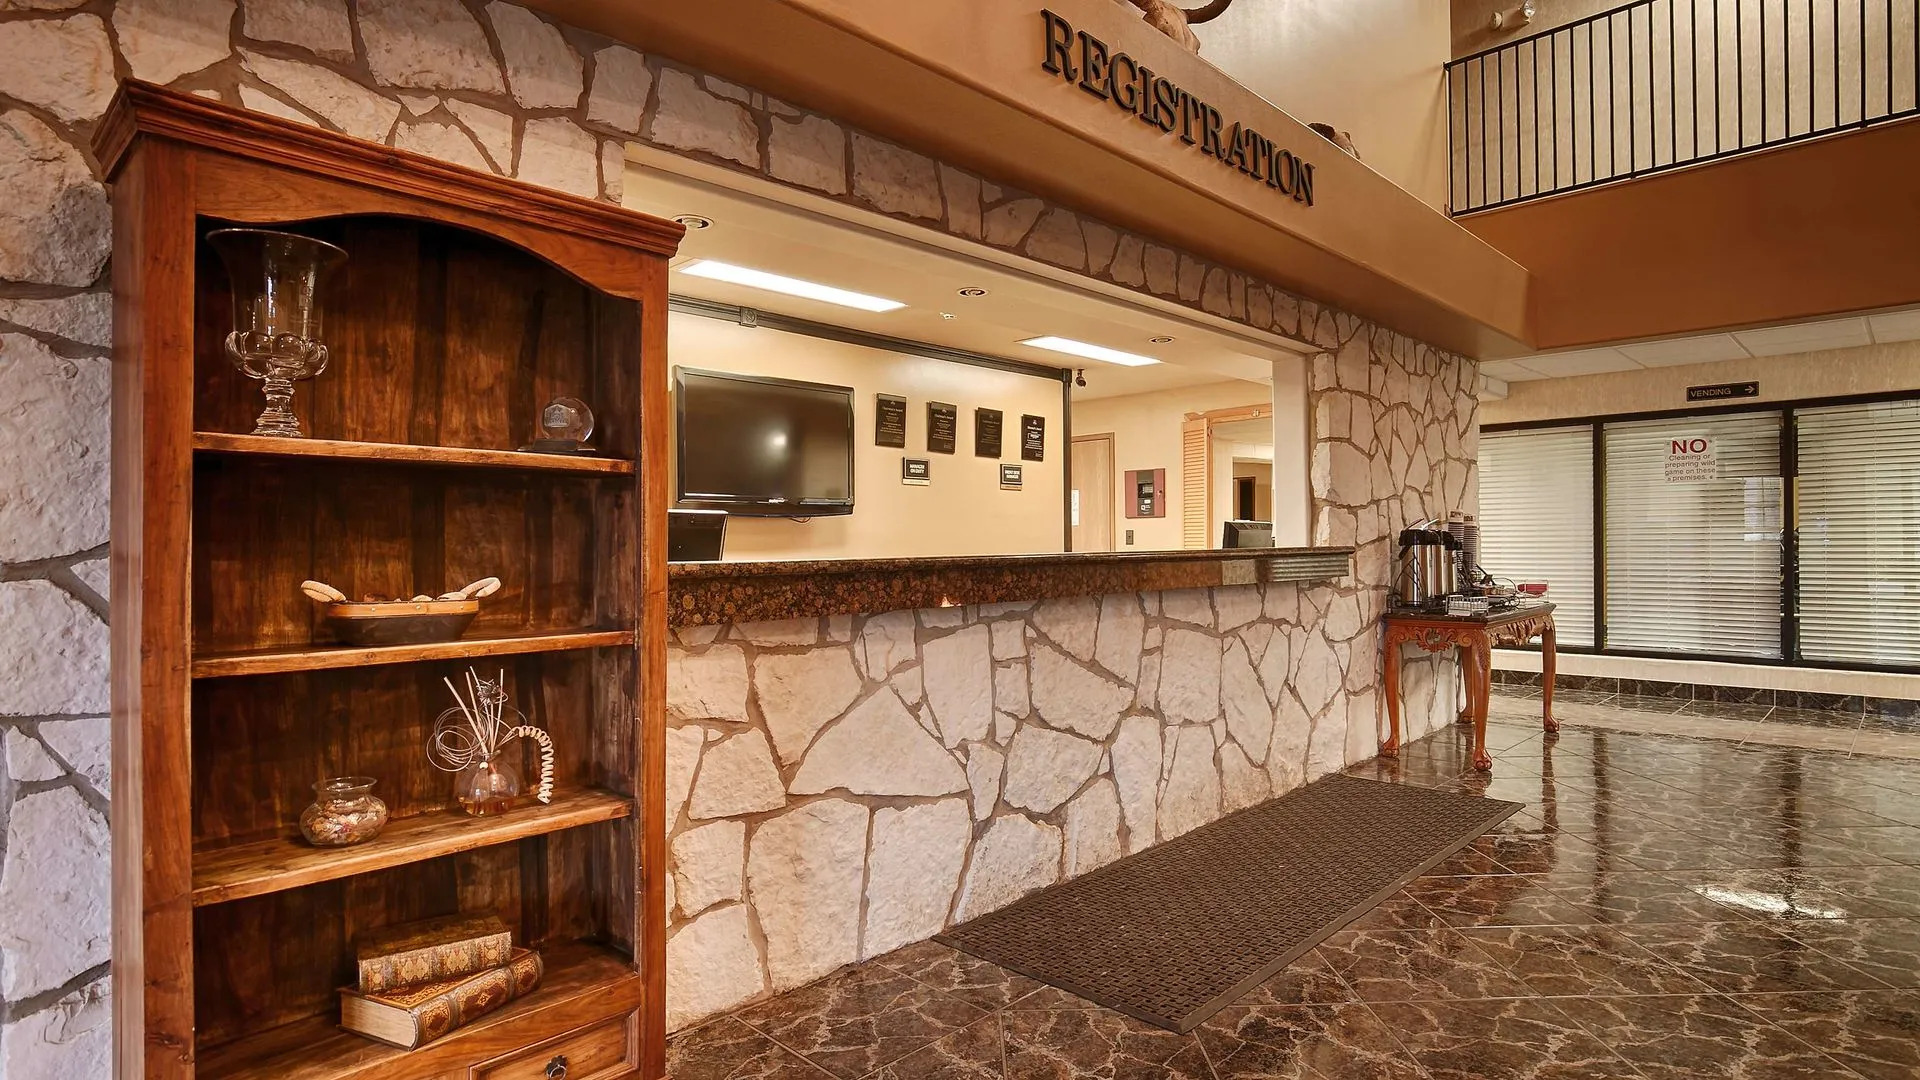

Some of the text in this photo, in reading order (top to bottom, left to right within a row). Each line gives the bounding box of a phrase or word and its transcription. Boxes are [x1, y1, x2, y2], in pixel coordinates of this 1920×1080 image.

[1040, 8, 1316, 207] REGISTRATION
[1690, 388, 1731, 397] VENDING
[1672, 439, 1707, 454] NO
[1664, 469, 1684, 477] game
